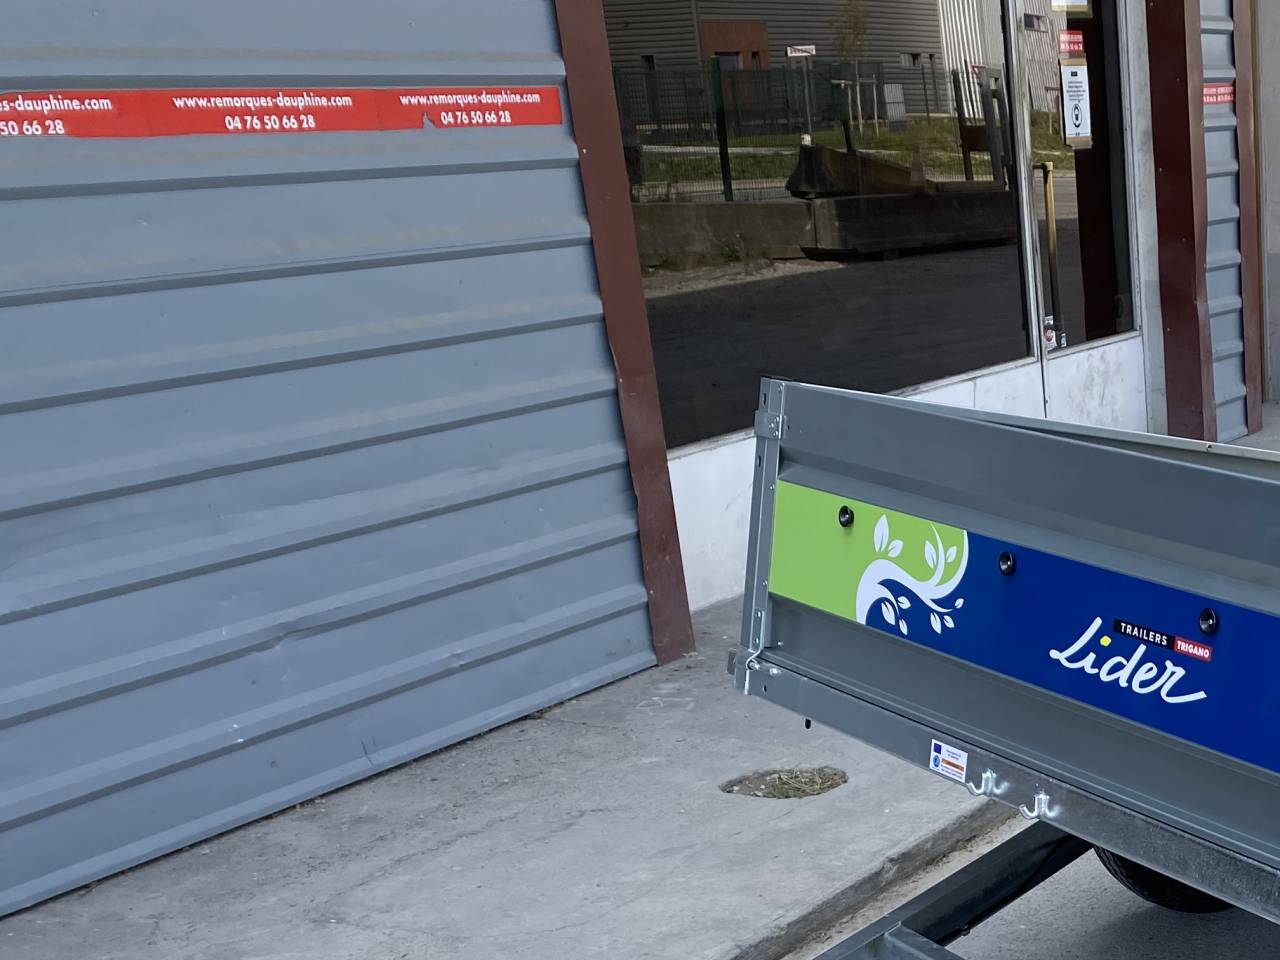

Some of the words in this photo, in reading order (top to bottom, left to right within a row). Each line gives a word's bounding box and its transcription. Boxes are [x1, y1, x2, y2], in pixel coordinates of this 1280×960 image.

[172, 91, 353, 111] www.remorques-dauphine.com
[399, 90, 541, 107] www.remorques-dauphine.com
[224, 115, 242, 130] 04
[244, 115, 261, 129] 76
[264, 115, 280, 129] 50
[282, 115, 299, 129] 66
[301, 114, 316, 128] 28
[440, 111, 454, 125] 04
[455, 111, 469, 124] 76
[471, 111, 483, 123] 50
[484, 111, 498, 123] 66
[499, 110, 511, 123] 28
[22, 120, 42, 135] 66
[44, 119, 65, 134] 28
[1120, 622, 1168, 646] TRAILERS
[1176, 640, 1210, 659] TRIGANO
[1049, 616, 1208, 704] Lider
